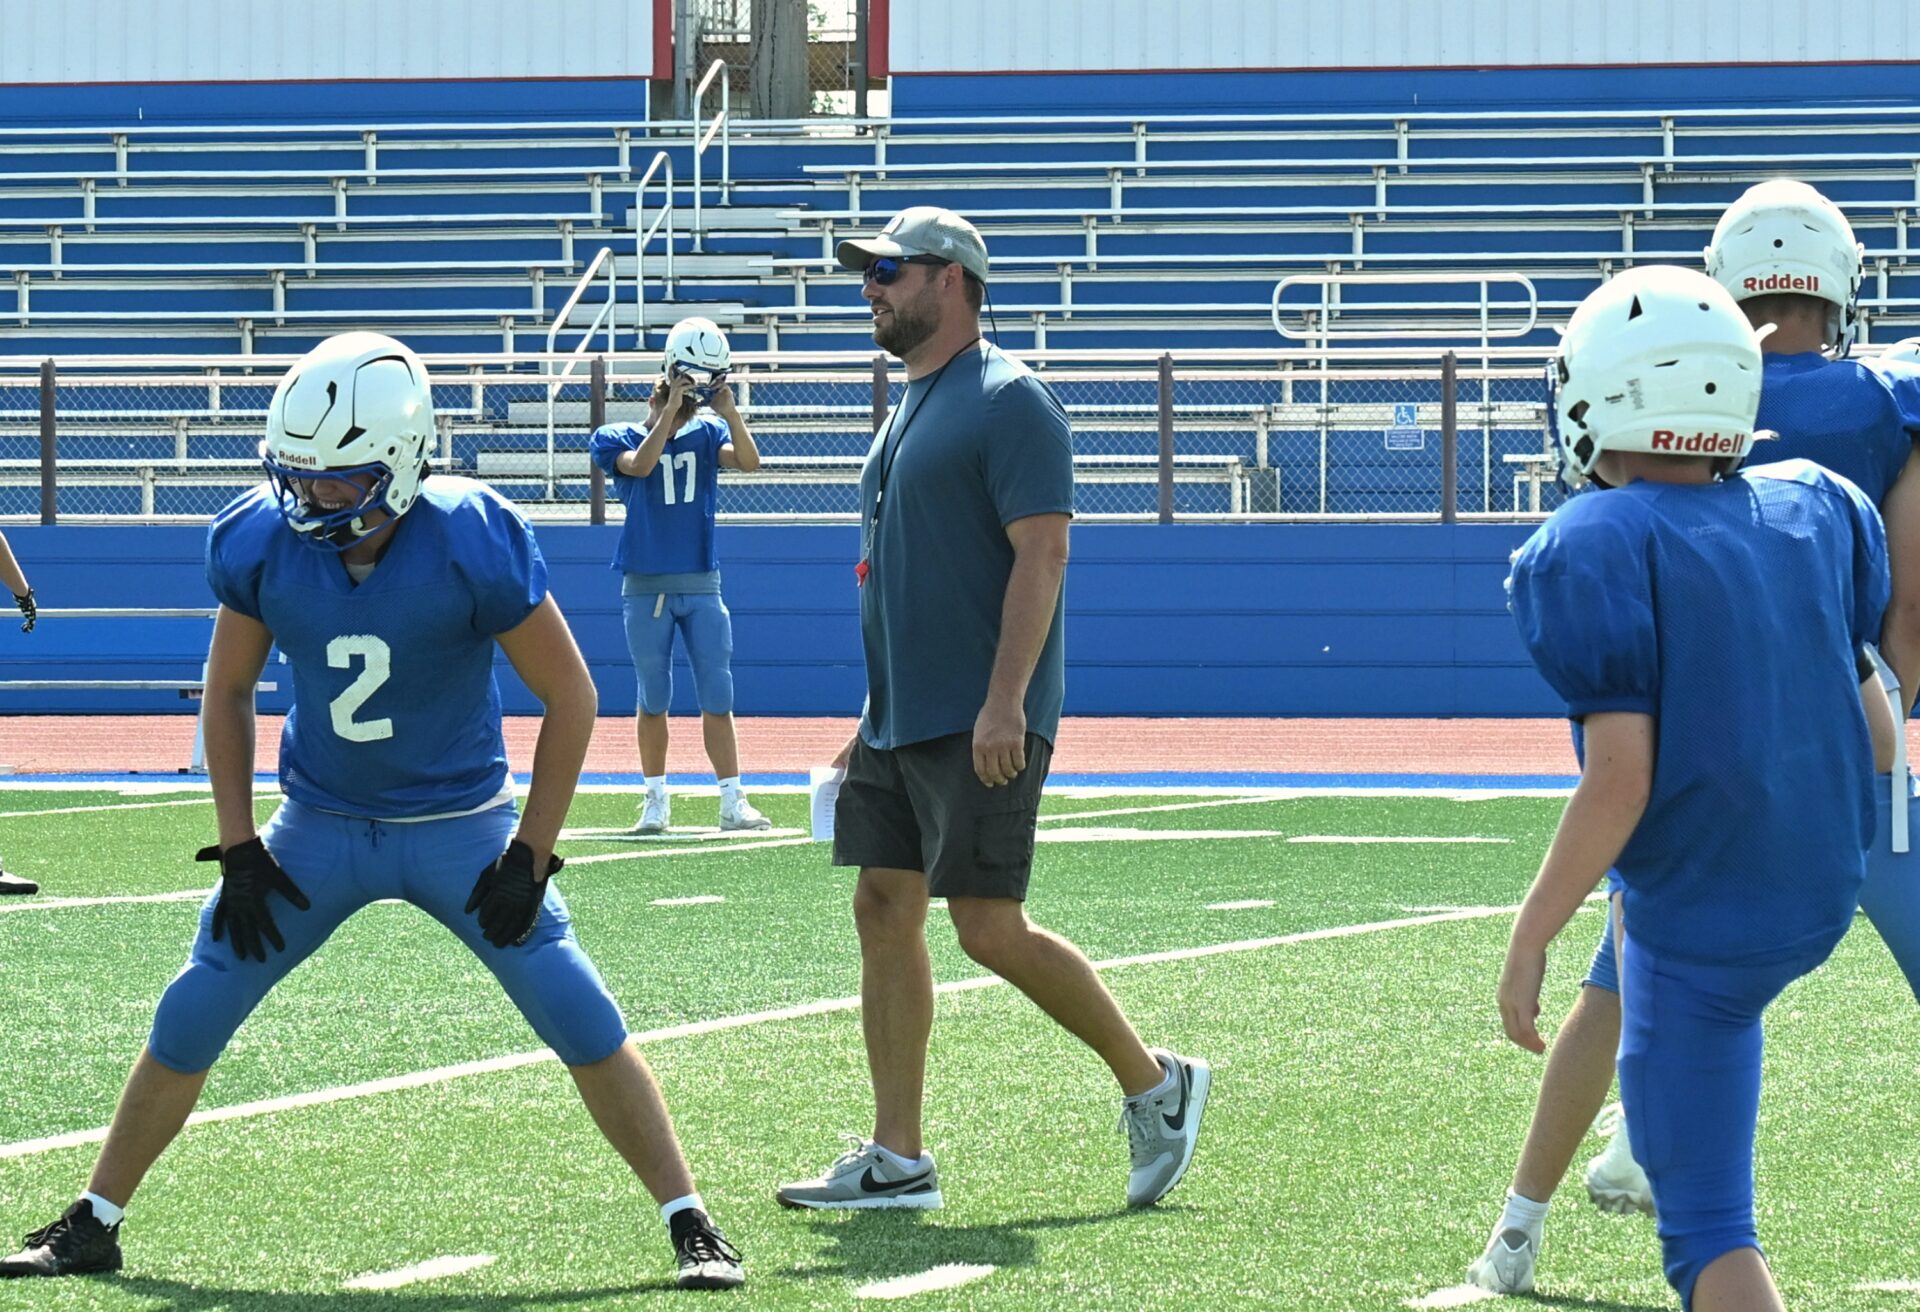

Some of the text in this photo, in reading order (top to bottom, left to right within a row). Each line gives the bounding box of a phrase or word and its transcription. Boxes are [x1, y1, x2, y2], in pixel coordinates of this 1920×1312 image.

[1743, 274, 1819, 292] Riddell
[1652, 430, 1745, 454] Riddell
[279, 450, 316, 466] Riddell
[659, 451, 696, 505] 17
[326, 634, 394, 742] 2
